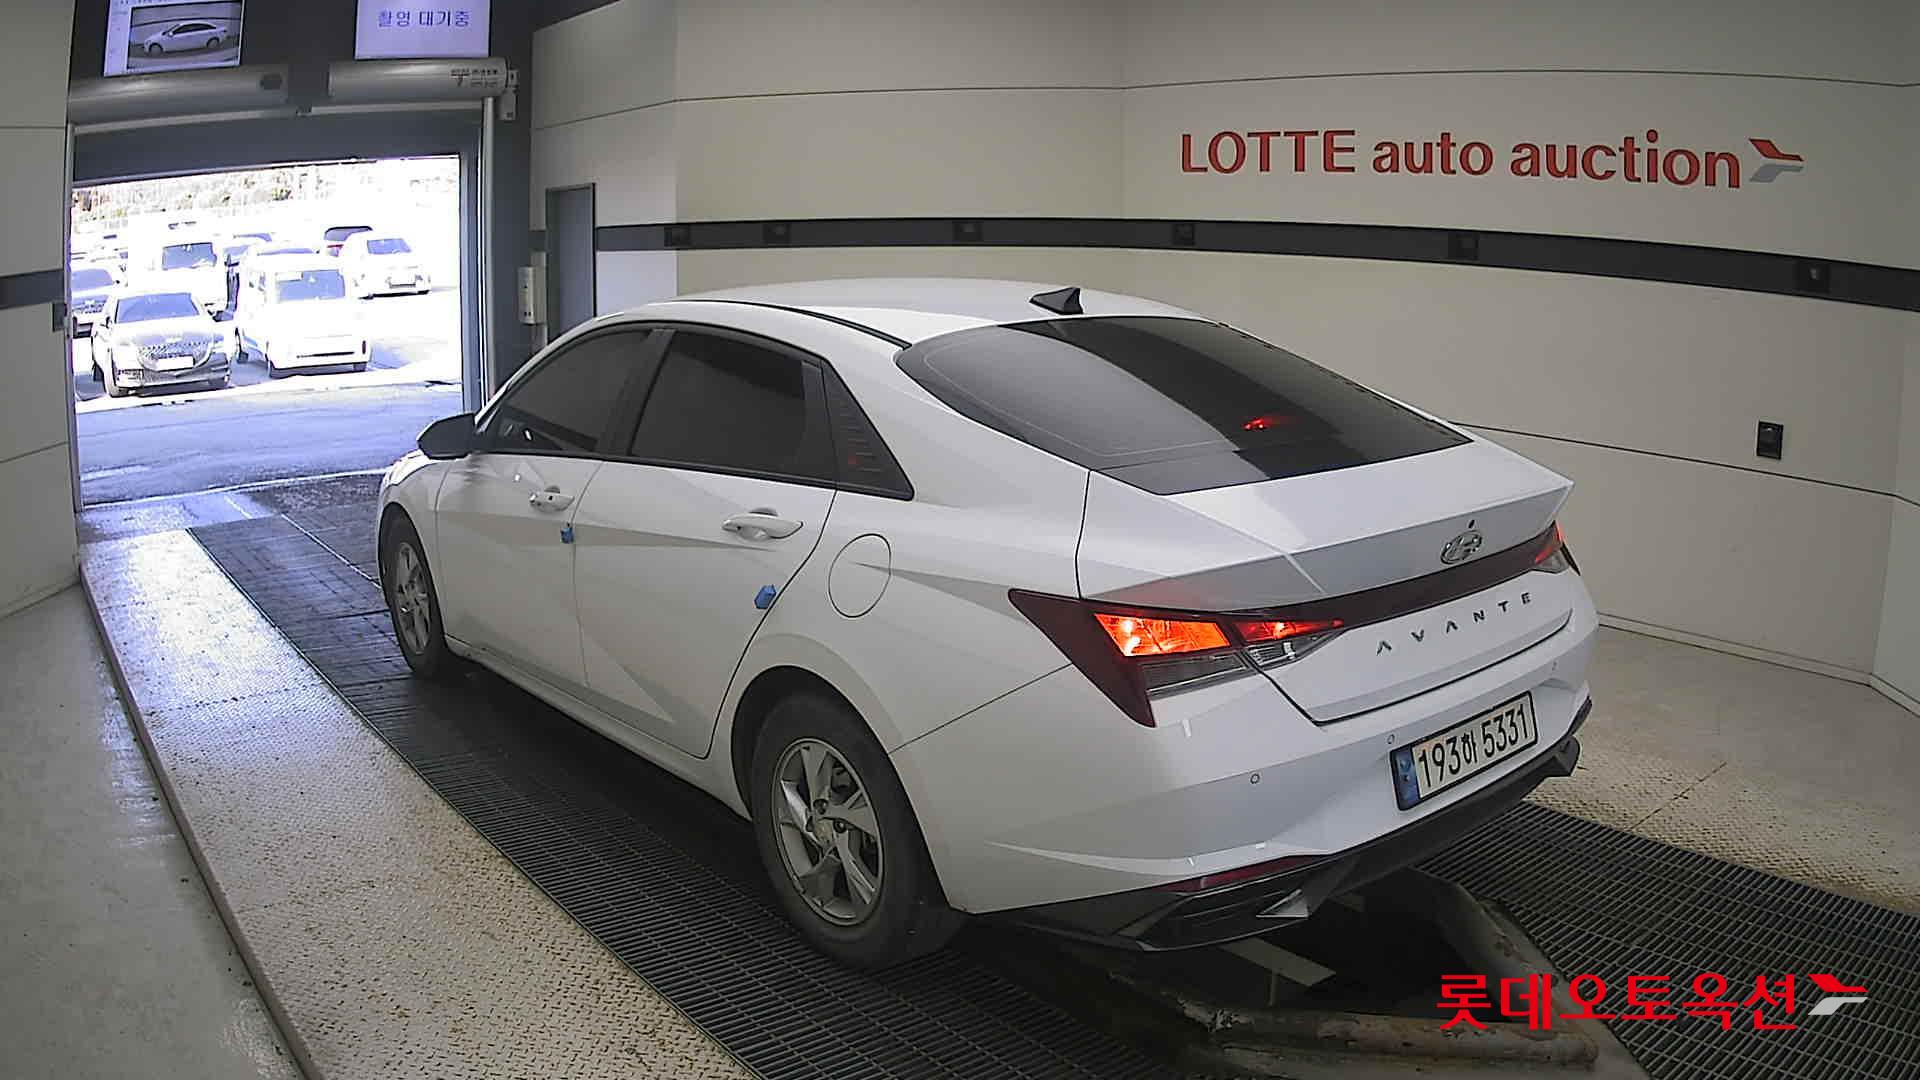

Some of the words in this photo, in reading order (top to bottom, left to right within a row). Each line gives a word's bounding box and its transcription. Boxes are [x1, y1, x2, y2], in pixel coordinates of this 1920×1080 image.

[1181, 130, 1356, 174] LOTTE
[1372, 131, 1494, 176] auto
[1510, 129, 1741, 188] auction
[1376, 592, 1532, 656] AVANTE
[1481, 703, 1528, 758] 5331
